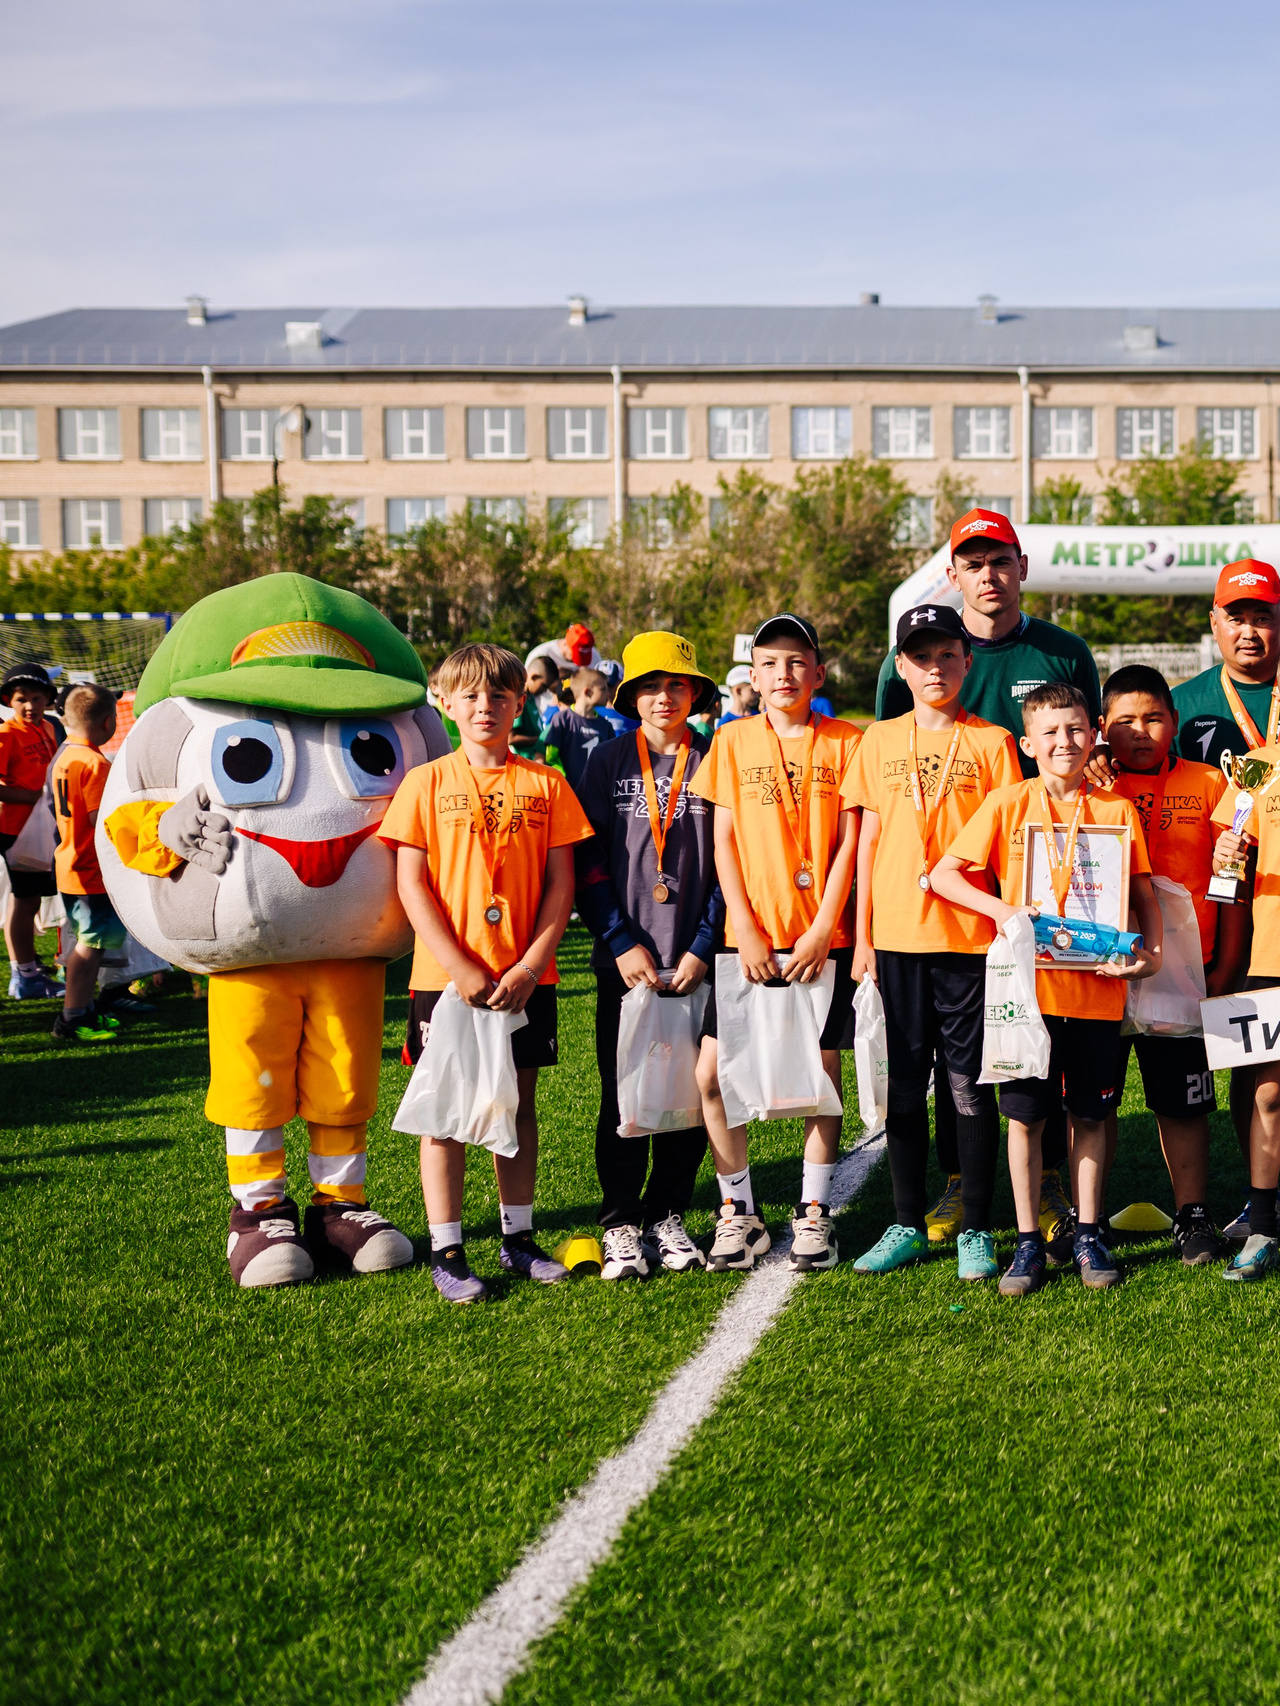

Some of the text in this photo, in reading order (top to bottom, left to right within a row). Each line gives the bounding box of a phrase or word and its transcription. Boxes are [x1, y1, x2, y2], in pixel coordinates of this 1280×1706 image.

[1051, 540, 1255, 572] МЕТРОШКА
[1079, 932, 1097, 941] 2025
[1186, 1070, 1213, 1105] 20
